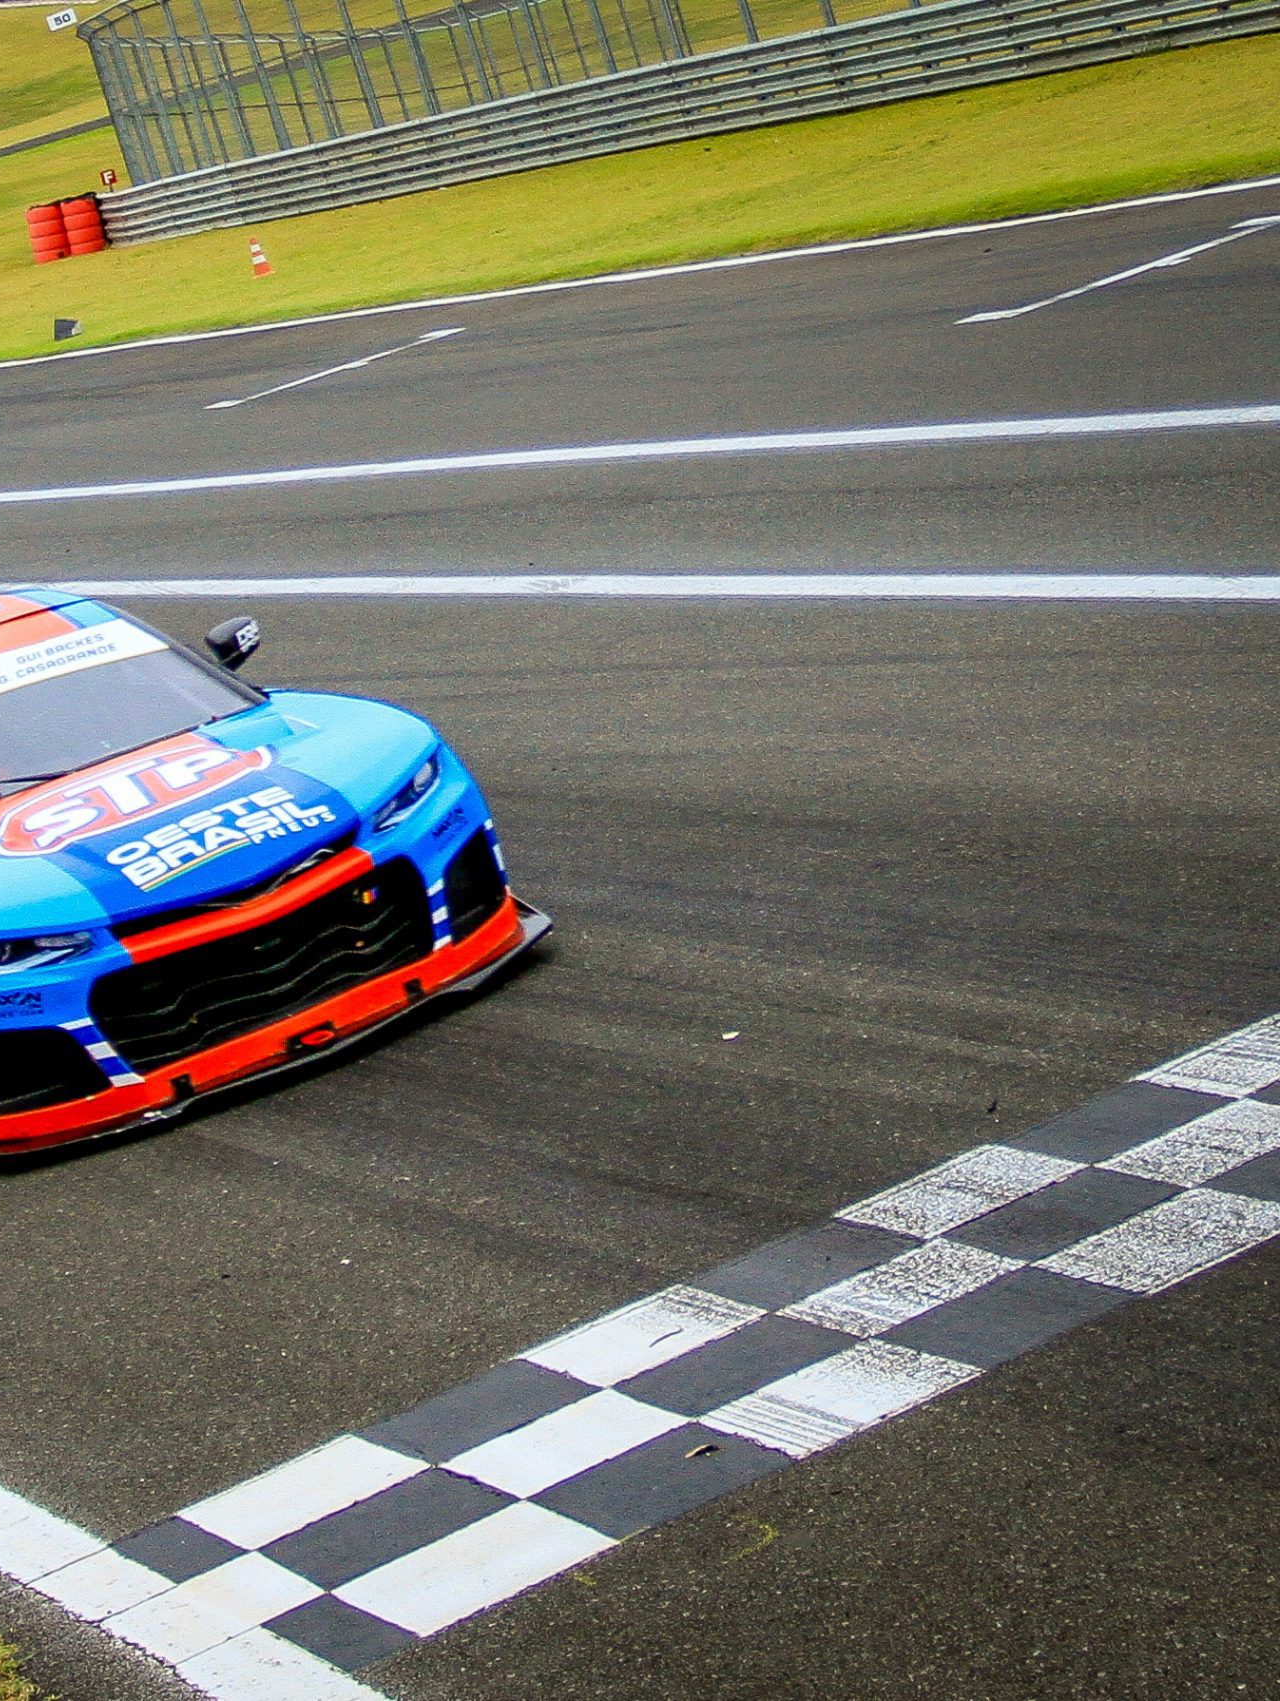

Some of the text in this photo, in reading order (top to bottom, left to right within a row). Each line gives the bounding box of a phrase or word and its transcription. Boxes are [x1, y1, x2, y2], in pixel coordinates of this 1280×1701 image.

[53, 13, 72, 26] 50
[102, 170, 114, 185] F
[15, 642, 117, 678] CASAGRANDE
[16, 633, 105, 665] GUI BACKES
[23, 748, 238, 849] STP
[105, 786, 296, 866] OESTE
[246, 811, 337, 846] PNEUS
[120, 802, 330, 887] BRASIL
